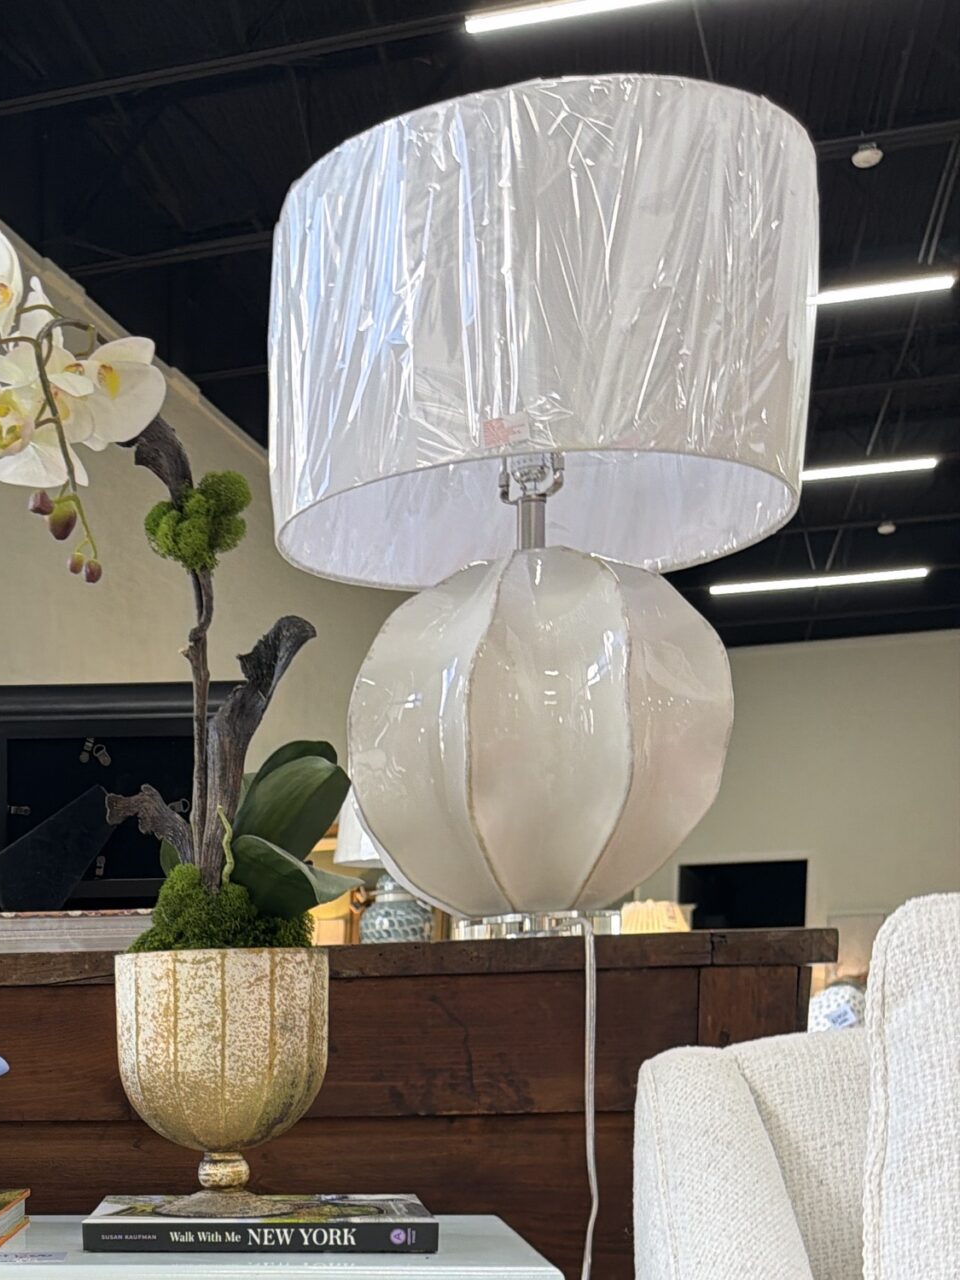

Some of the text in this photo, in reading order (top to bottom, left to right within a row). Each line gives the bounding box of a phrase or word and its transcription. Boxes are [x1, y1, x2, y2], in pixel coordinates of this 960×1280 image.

[169, 1227, 357, 1247] Walk With Me NEW YORK
